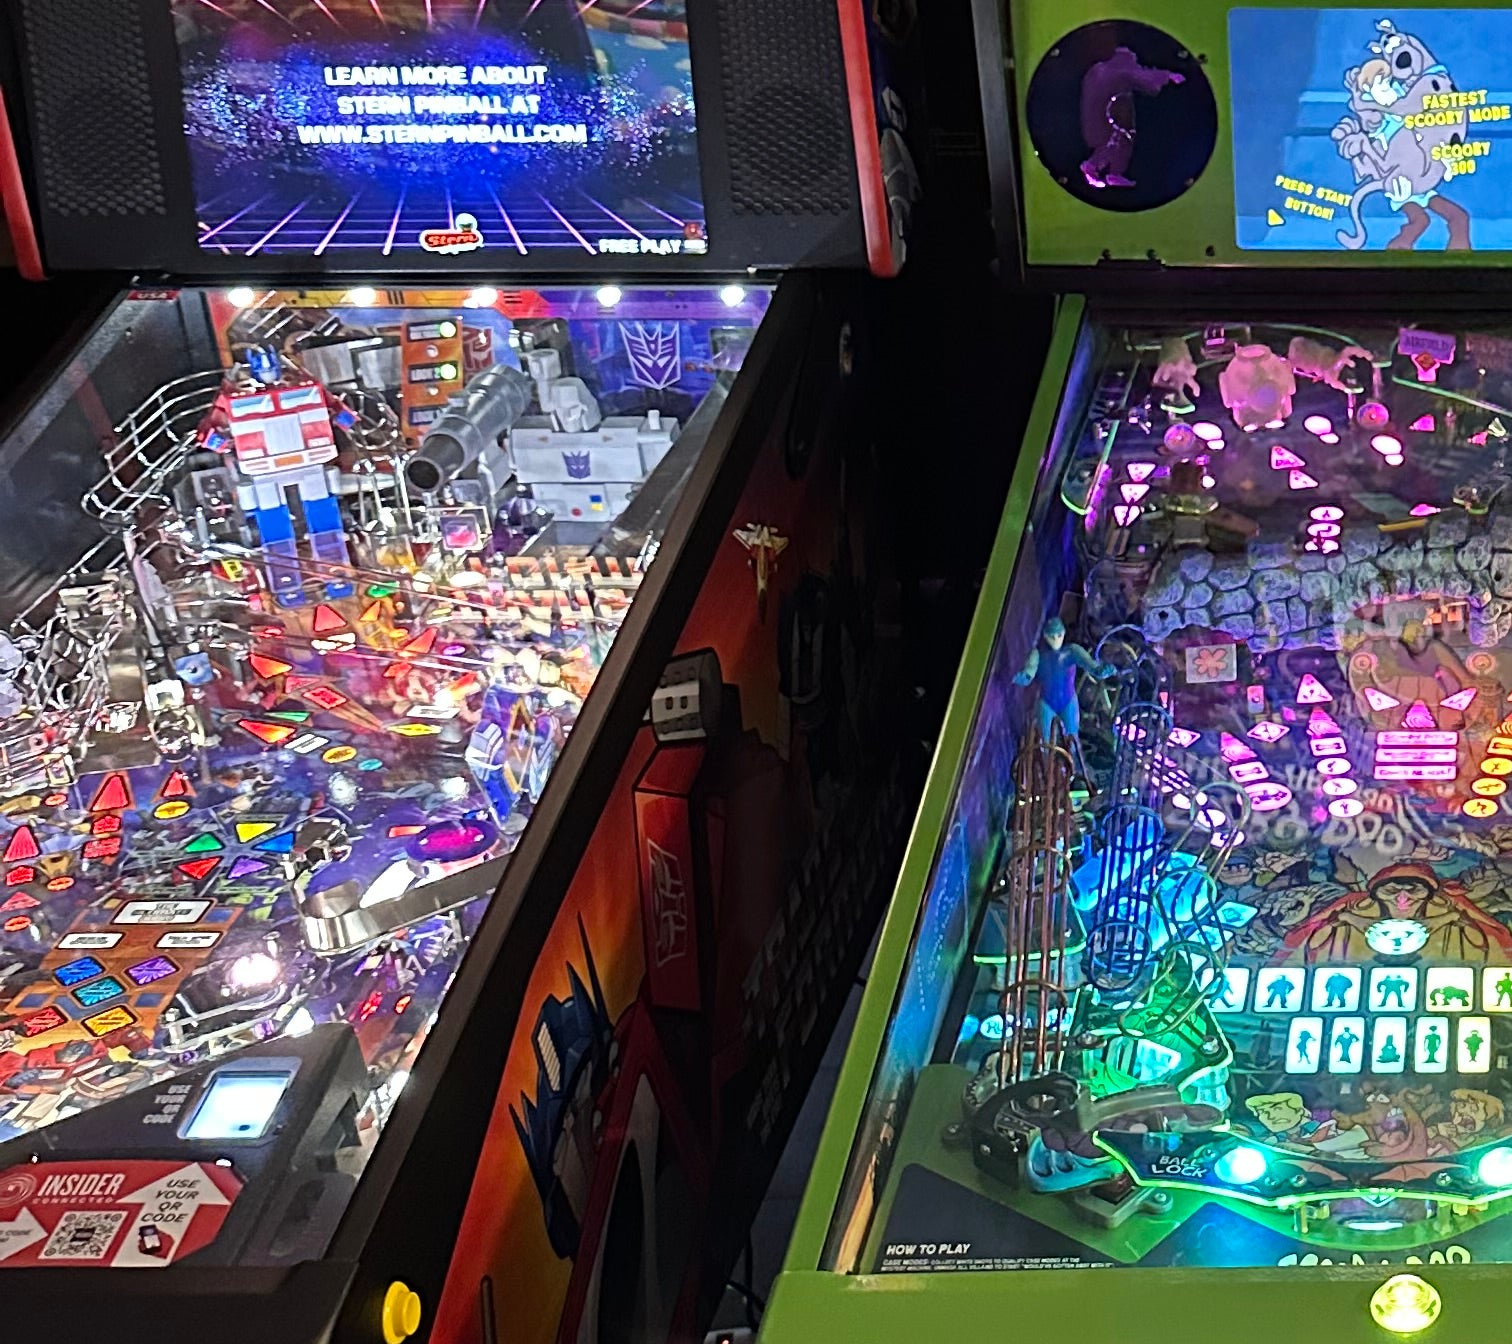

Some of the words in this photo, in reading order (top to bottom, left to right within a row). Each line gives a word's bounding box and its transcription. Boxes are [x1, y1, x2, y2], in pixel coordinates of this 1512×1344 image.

[323, 66, 399, 86] LEARN
[400, 65, 469, 86] MORE
[471, 65, 548, 85] ABOUT
[336, 95, 411, 115] STERN
[413, 95, 509, 115] PINBALL
[509, 95, 541, 115] AT
[1422, 90, 1488, 111] FASTEST
[1404, 110, 1464, 130] SCOOBY
[1468, 105, 1512, 124] MODE
[296, 123, 588, 144] WWW.STERNPINBALL.COM
[1431, 141, 1491, 161] SCOOBY
[1450, 159, 1477, 177] 300
[1275, 175, 1315, 197] PRESS
[1315, 187, 1354, 208] START
[426, 232, 477, 246] Stern
[599, 239, 639, 254] FREE
[641, 238, 682, 255] PLAY
[154, 1094, 187, 1104] YOUR
[142, 1114, 176, 1124] CODE
[1158, 1155, 1201, 1169] BALL
[1151, 1164, 1207, 1179] LOCK
[37, 1173, 126, 1197] INSIDER
[166, 1179, 201, 1189] USE
[32, 1196, 116, 1205] CONNECTED
[155, 1190, 200, 1200] YOUR
[158, 1201, 183, 1212] QR
[141, 1213, 189, 1223] CODE
[887, 1244, 917, 1255] HOW
[919, 1244, 937, 1255] TO
[938, 1243, 970, 1255] PLAY
